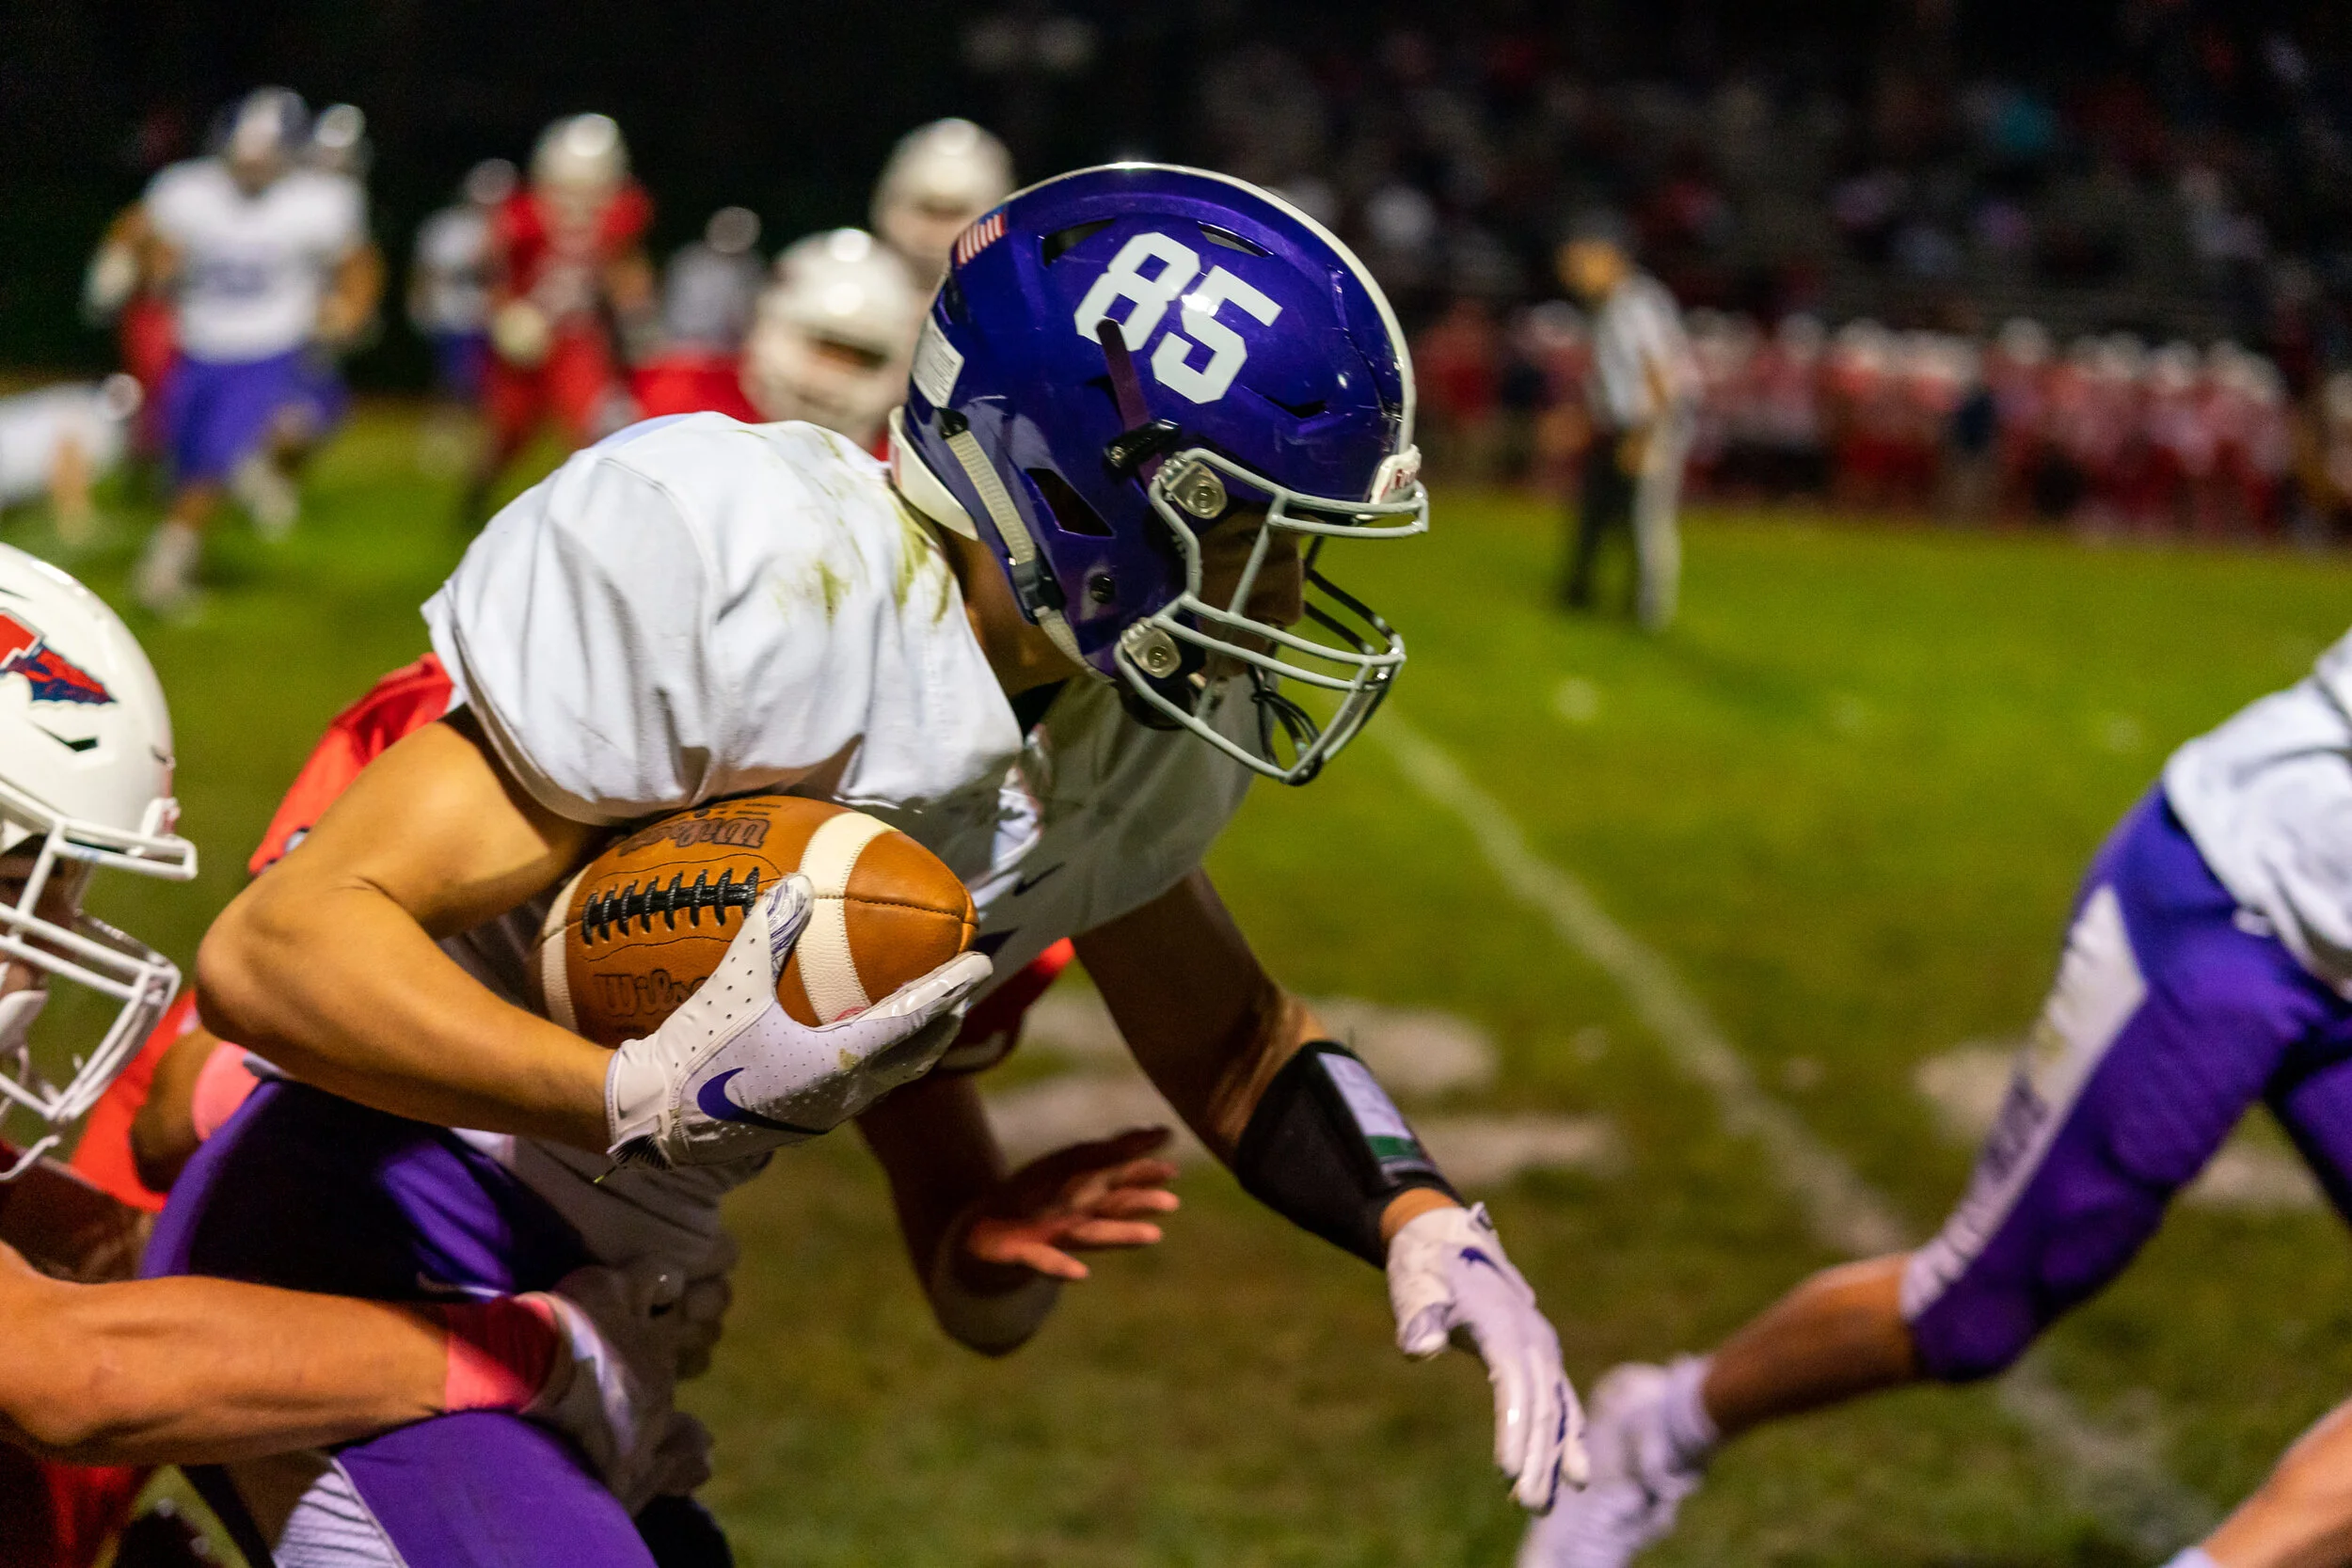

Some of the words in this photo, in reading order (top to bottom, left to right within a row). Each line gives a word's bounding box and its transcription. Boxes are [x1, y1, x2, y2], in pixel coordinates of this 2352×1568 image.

[1074, 232, 1283, 404] 85
[617, 816, 771, 857] Wils
[594, 969, 708, 1017] Wils
